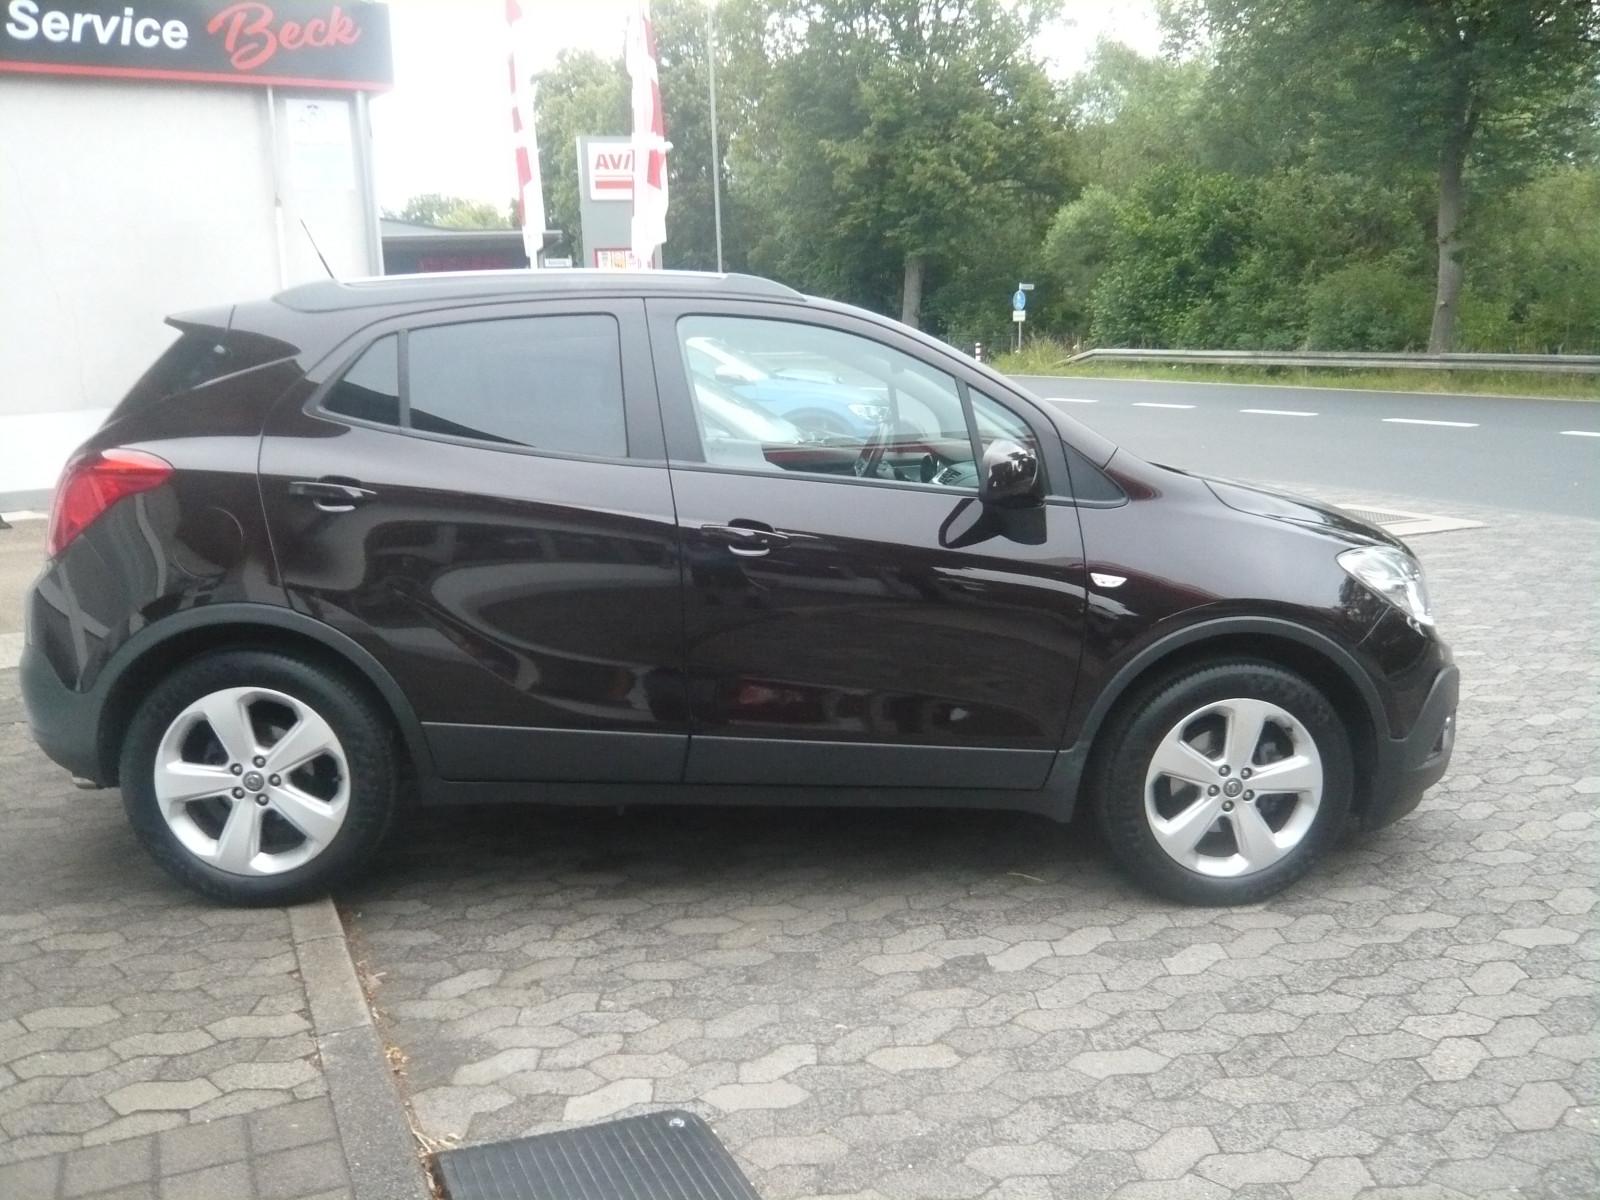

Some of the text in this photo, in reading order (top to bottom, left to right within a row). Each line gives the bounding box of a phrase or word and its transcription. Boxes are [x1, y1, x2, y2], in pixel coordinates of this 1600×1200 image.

[6, 0, 362, 71] Service Beck
[595, 153, 632, 170] AVI
